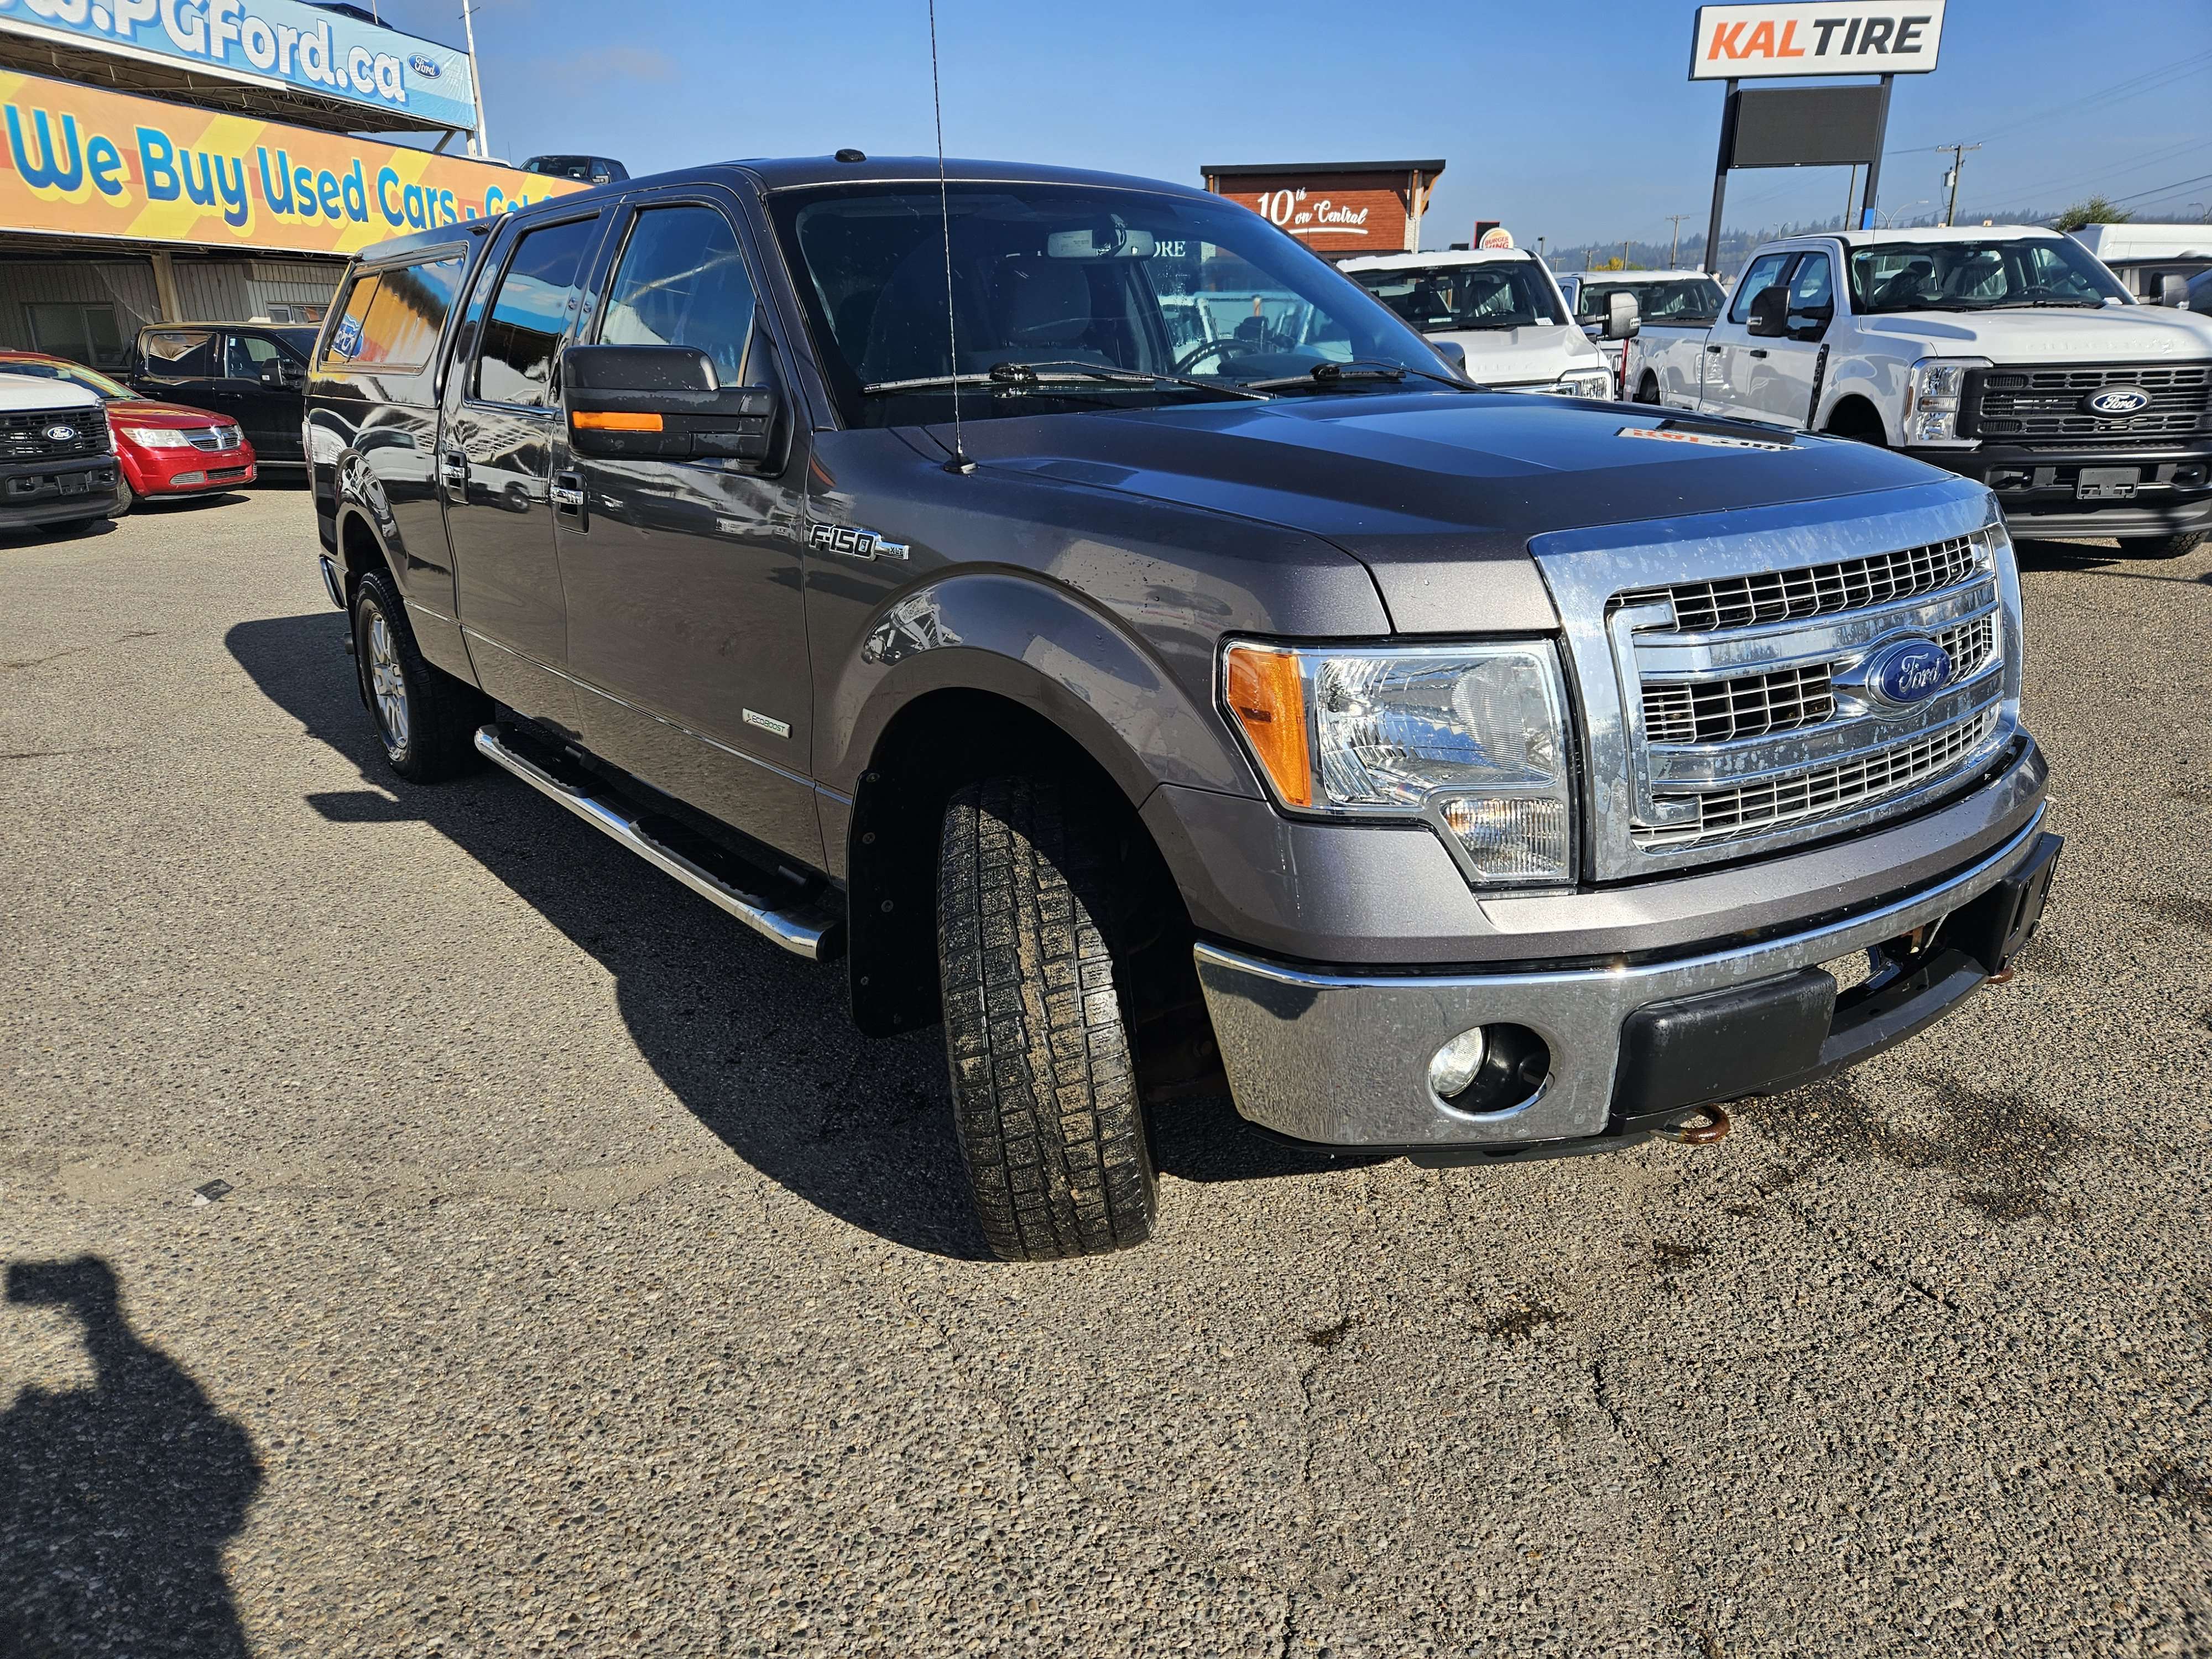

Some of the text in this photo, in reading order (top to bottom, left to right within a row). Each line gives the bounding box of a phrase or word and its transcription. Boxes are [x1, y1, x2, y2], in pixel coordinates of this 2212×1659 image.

[1707, 15, 1932, 60] KAL TIRE
[415, 56, 436, 76] Ford
[3, 103, 458, 229] We Buy Used Cars
[1295, 212, 1312, 225] on
[1313, 200, 1369, 225] Central
[1485, 236, 1509, 246] BURGER
[2103, 394, 2138, 409] Ford
[53, 429, 70, 438] Ford
[1898, 653, 1942, 693] Ford
[752, 715, 785, 733] ECOBOOST
